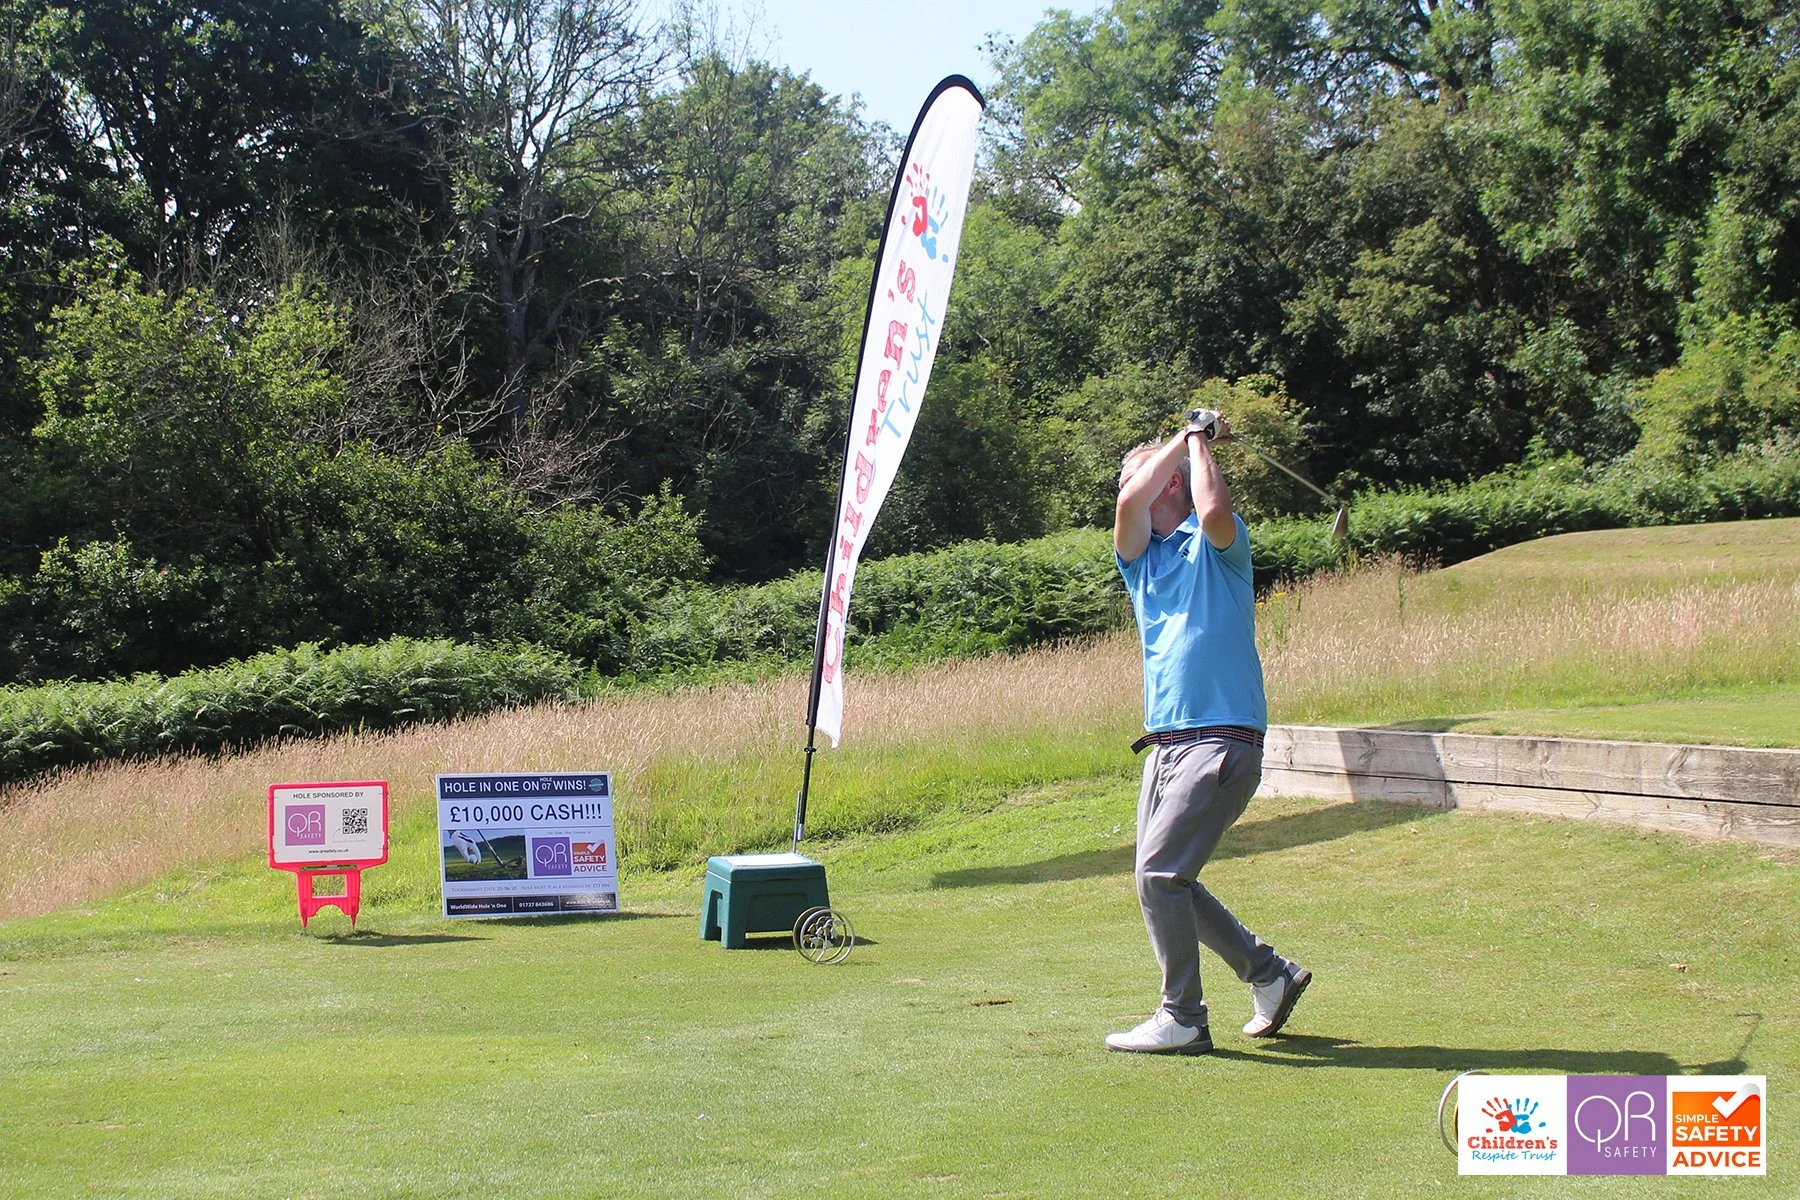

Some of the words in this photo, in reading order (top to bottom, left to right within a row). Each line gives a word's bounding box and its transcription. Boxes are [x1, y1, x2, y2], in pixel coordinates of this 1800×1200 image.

[879, 289, 935, 438] Trust
[822, 260, 916, 684] Children's
[312, 791, 354, 799] SPONSORED
[444, 782, 476, 793] HOLE
[479, 781, 491, 792] IN
[495, 780, 519, 792] ONE
[522, 780, 539, 791] ON
[541, 782, 551, 790] 07
[553, 779, 586, 790] WINS!
[288, 810, 321, 837] QR
[450, 805, 523, 824] £10,000
[530, 803, 602, 821] CASH!!!
[535, 842, 567, 867] QR
[573, 855, 605, 863] SAFETY
